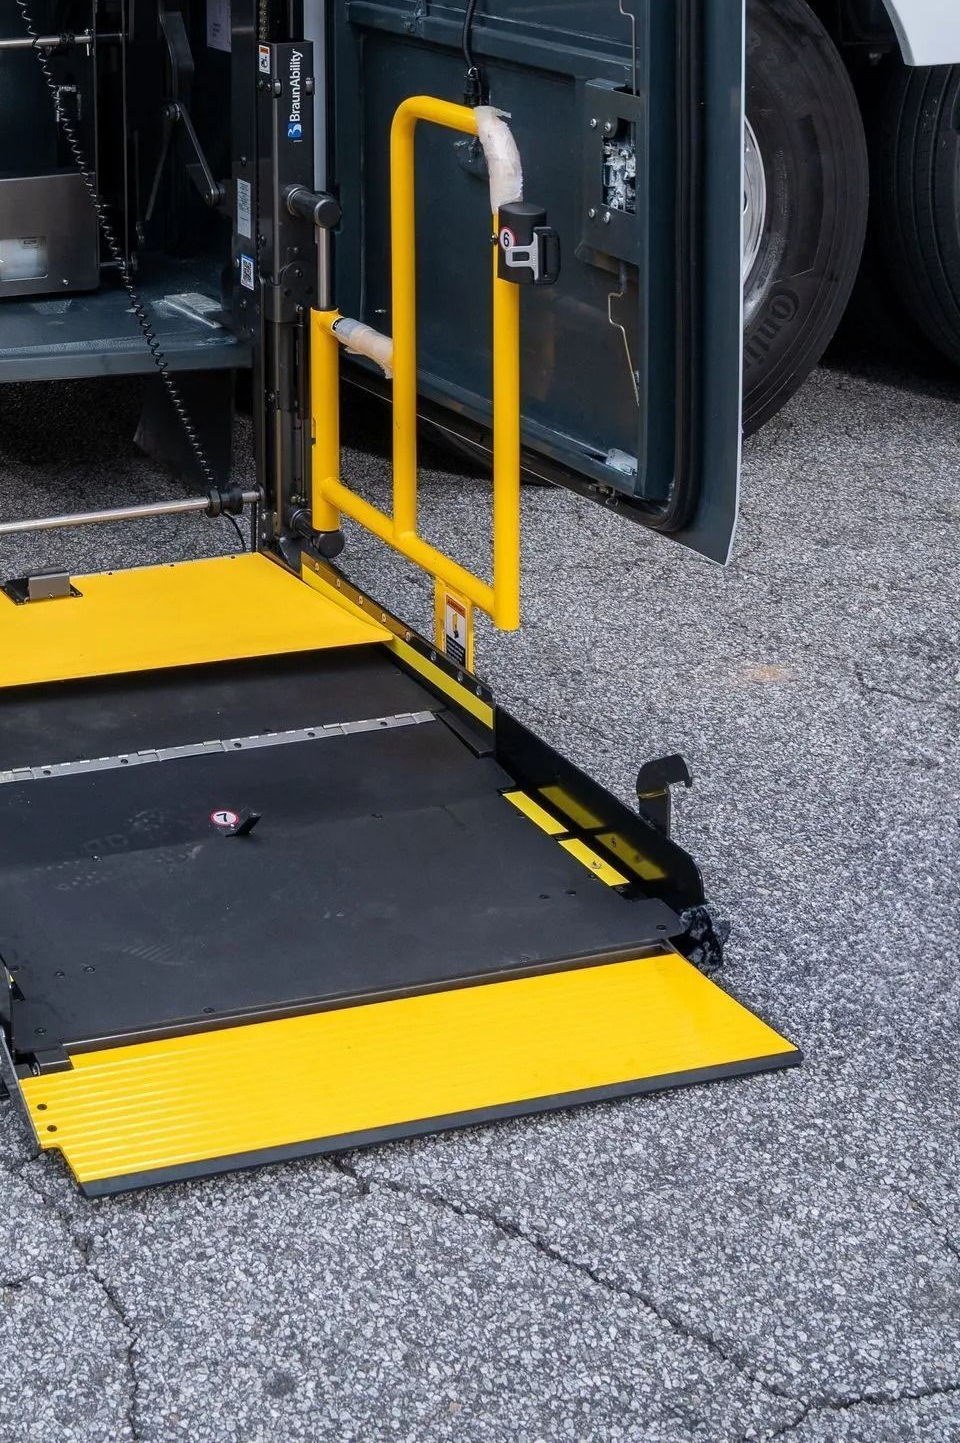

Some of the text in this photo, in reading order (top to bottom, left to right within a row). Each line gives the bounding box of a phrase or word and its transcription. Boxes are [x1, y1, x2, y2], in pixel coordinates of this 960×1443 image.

[289, 49, 304, 122] BraunAbility
[503, 231, 510, 247] 6
[216, 812, 228, 823] 7
